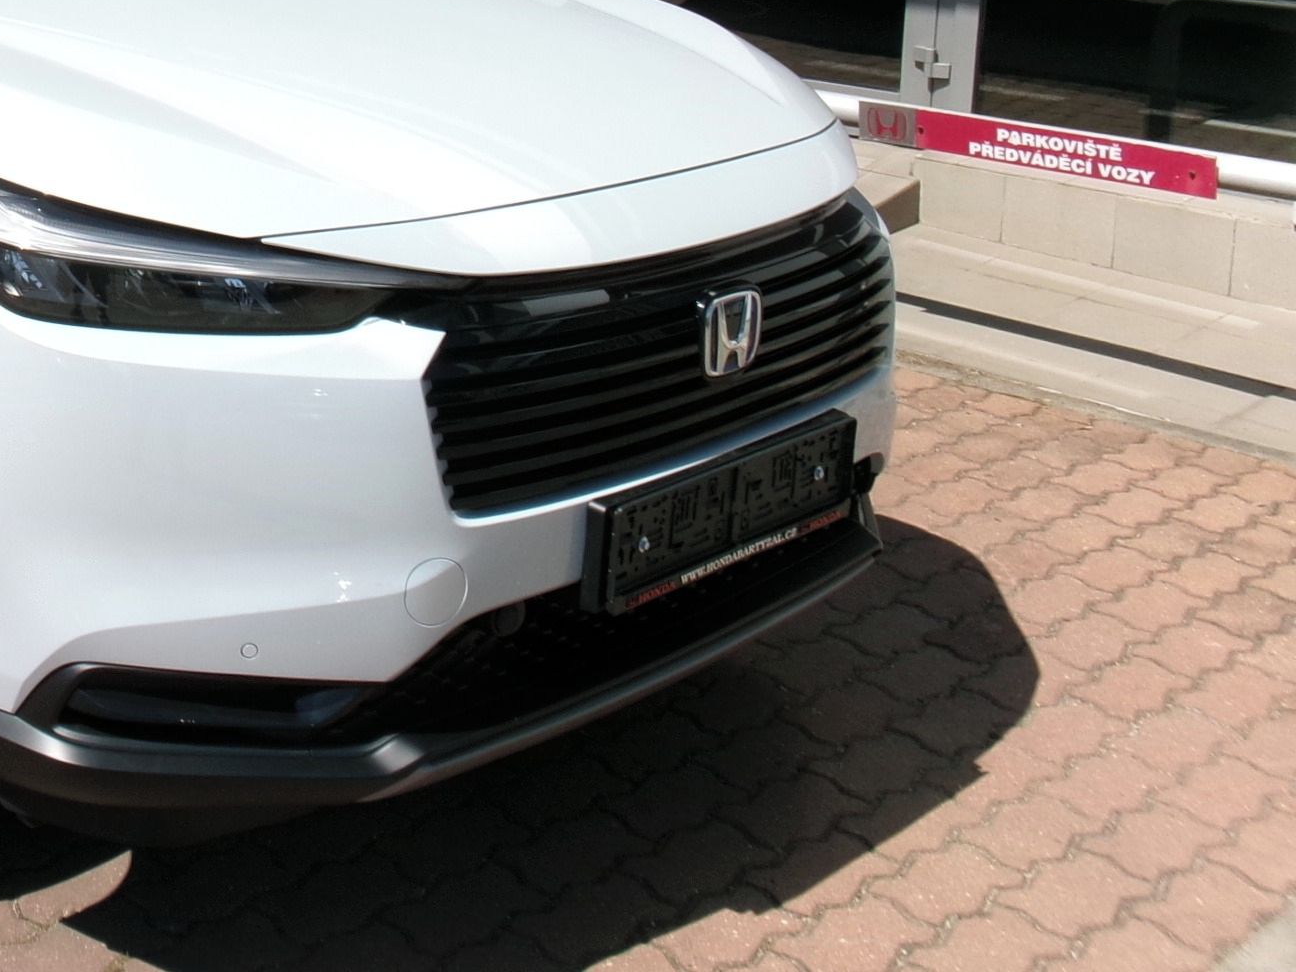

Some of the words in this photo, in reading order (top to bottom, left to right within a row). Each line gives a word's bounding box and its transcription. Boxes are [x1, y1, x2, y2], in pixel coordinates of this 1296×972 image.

[968, 141, 1092, 175] PŘEDVÁDĚCÍ
[1099, 165, 1155, 185] VOZY
[996, 128, 1122, 162] PARKOVIŠTĚ
